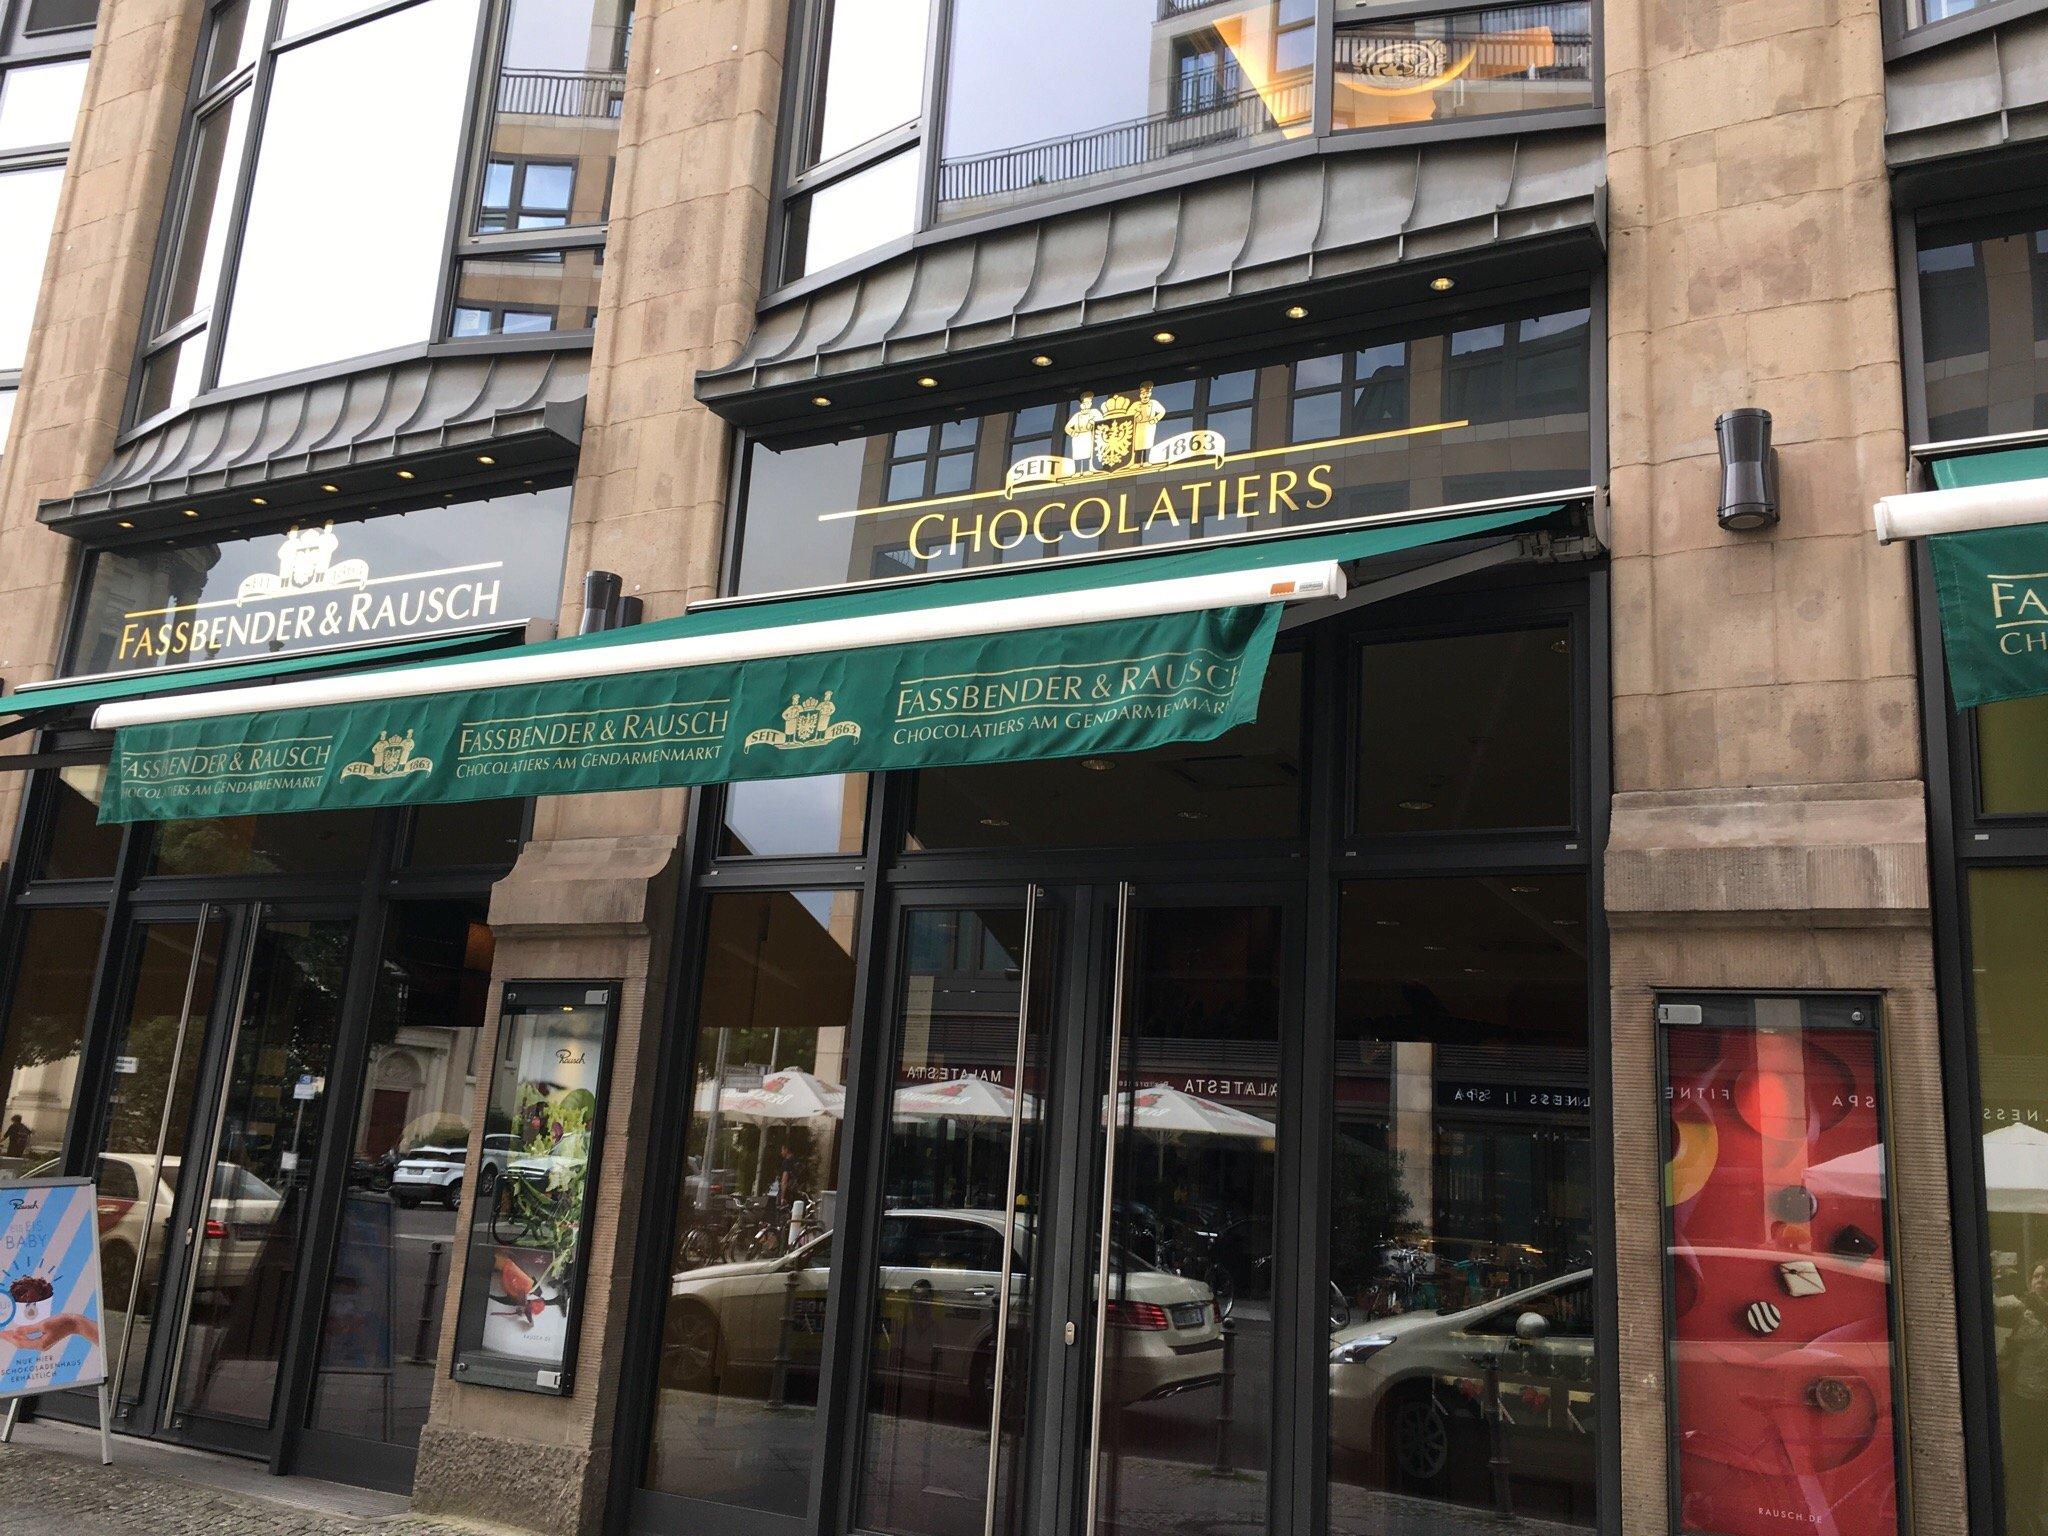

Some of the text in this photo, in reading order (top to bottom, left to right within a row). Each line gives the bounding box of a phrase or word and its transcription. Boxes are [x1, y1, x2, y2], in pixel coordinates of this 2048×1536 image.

[1013, 434, 1216, 481] SEIT 1863
[908, 464, 1333, 560] CHOCOLATIERS
[118, 580, 500, 660] FASSBENDER & RAUSCH
[897, 676, 1082, 717] FASSBENDER
[1091, 673, 1111, 699] &
[460, 710, 729, 754] FASSBENDER & RAUSCH
[751, 723, 857, 743] SEIT 1863
[894, 697, 1231, 745] CHOCOLATIERS AM GENDARMENMAR
[229, 752, 244, 771] &
[250, 745, 332, 770] RAUSCH
[347, 764, 369, 774] SEIT
[456, 745, 723, 779] CHOCOLATIERS AM GENDARMENMARKT
[192, 785, 214, 796] AM
[214, 776, 324, 795] GENDARMENMARKT
[1758, 1507, 1822, 1523] RAUSCH.DE
